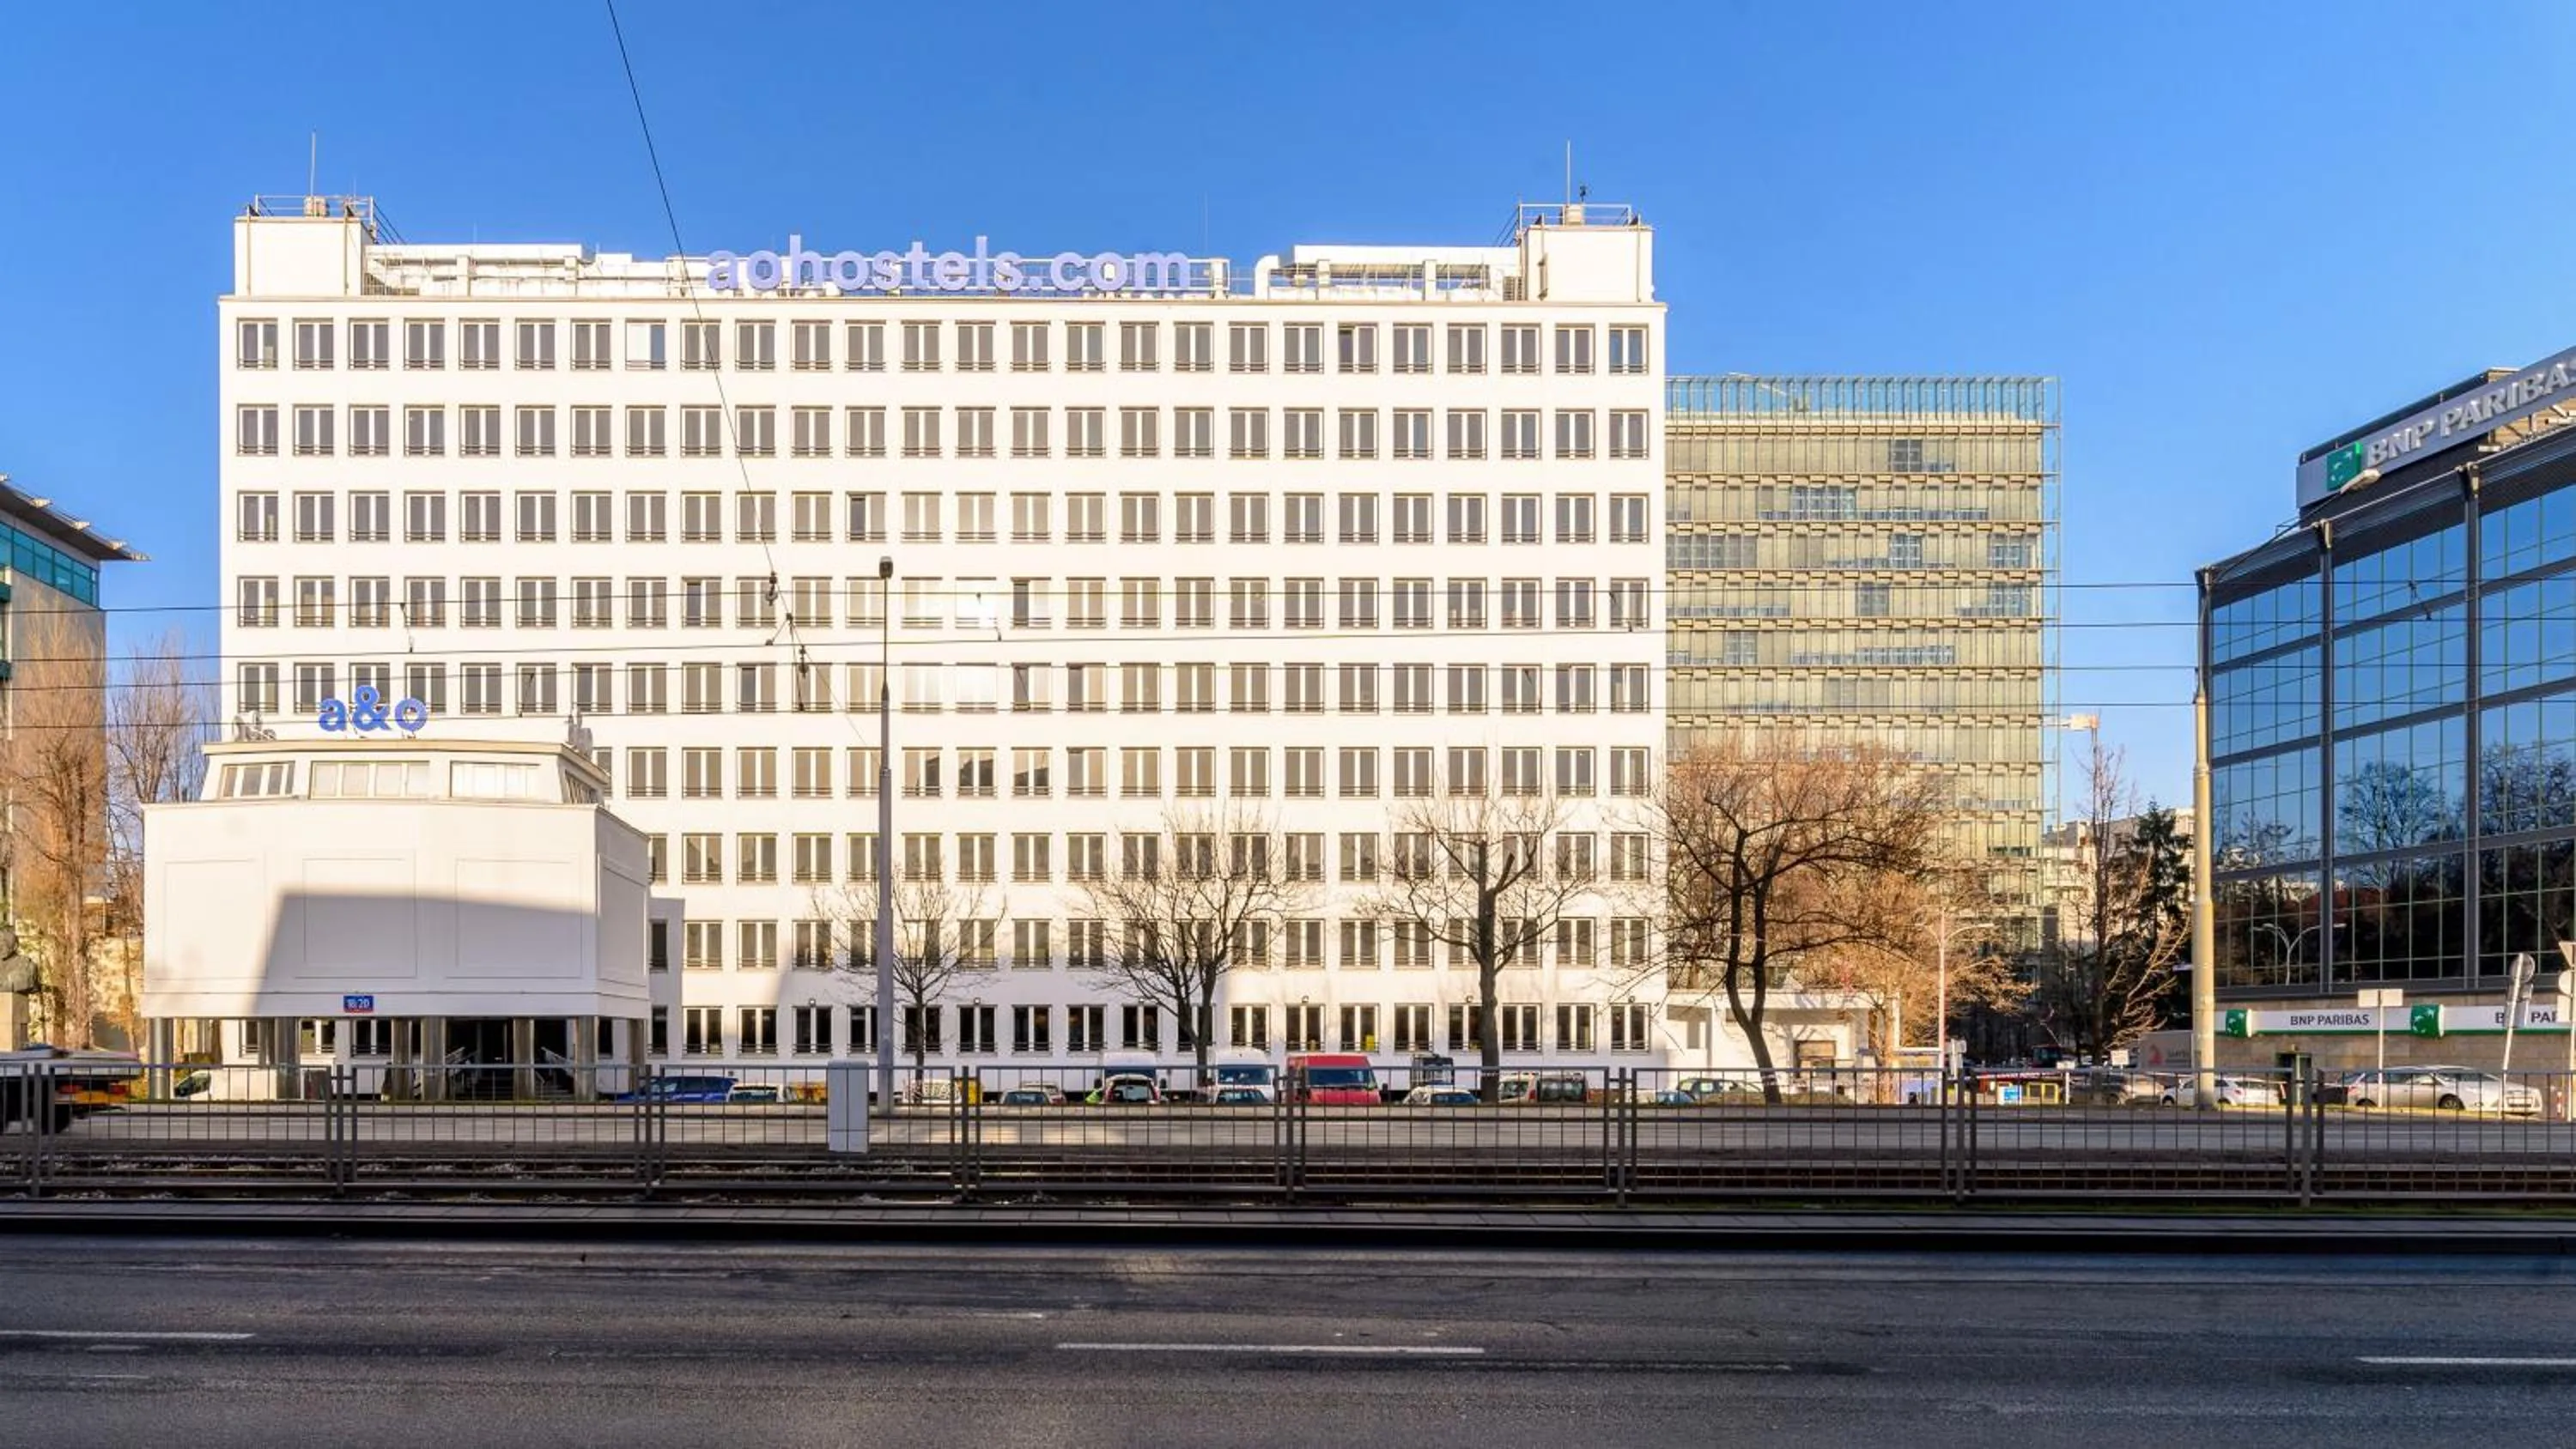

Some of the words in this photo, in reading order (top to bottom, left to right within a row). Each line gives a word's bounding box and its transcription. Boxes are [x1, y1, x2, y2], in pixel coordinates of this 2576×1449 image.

[708, 234, 1190, 292] aohostels.com
[2367, 420, 2434, 467] BNP
[319, 685, 428, 732] a&o
[2290, 1016, 2315, 1026] BNP
[2318, 1014, 2370, 1026] PARIBAS
